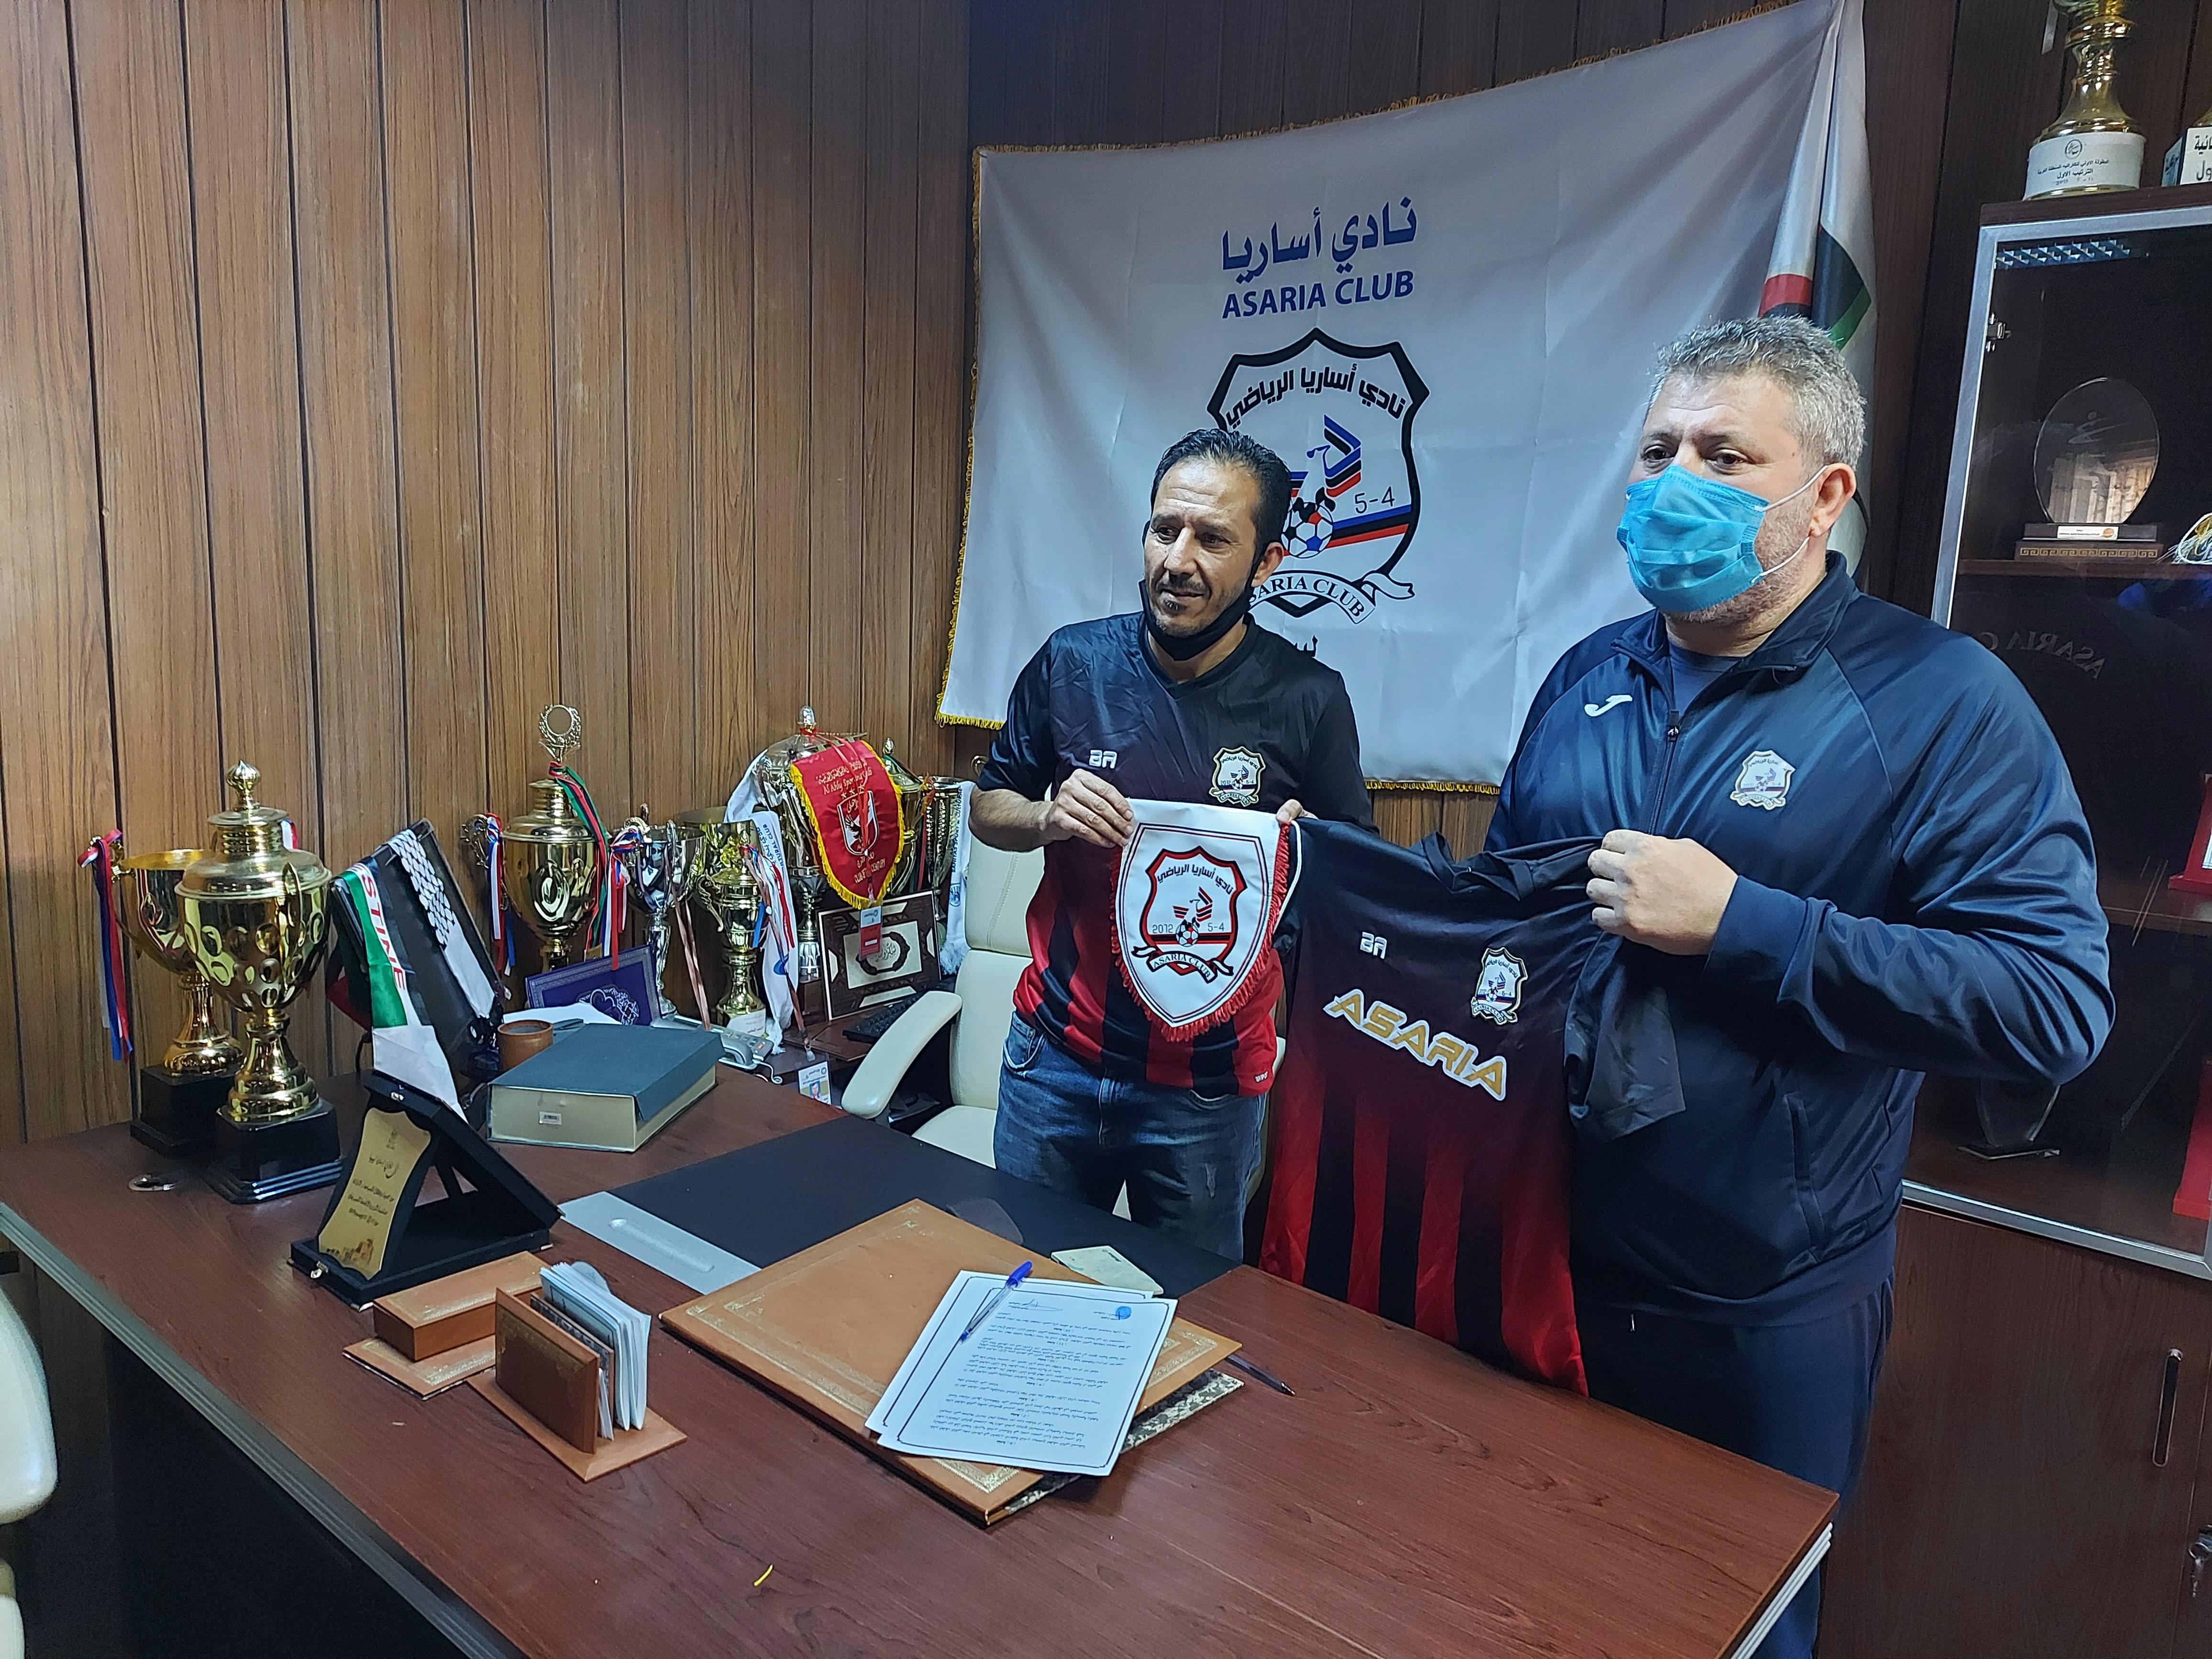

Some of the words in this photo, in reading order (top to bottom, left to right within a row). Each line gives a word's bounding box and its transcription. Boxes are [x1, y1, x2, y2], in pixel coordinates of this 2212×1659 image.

[2194, 135, 2212, 155] انية
[1222, 206, 1322, 284] أساريا
[1331, 196, 1417, 274] نادي
[1222, 283, 1327, 319] ASARIA
[1335, 271, 1414, 305] CLUB
[1301, 363, 1358, 393] أساريا
[1226, 369, 1294, 429] الرياضي
[1359, 380, 1406, 420] نادي
[1355, 486, 1395, 514] 5-4
[1313, 579, 1365, 617] CLUB
[763, 824, 773, 840] CLUB
[1157, 863, 1190, 884] الرياضي
[1192, 864, 1217, 880] أساريا
[1216, 875, 1234, 895] نادي
[1152, 924, 1173, 934] 2012
[1208, 922, 1225, 932] 5-4
[1153, 953, 1187, 970] ASARIA
[1189, 957, 1211, 978] CLUB
[1325, 990, 1506, 1099] ASARIA
